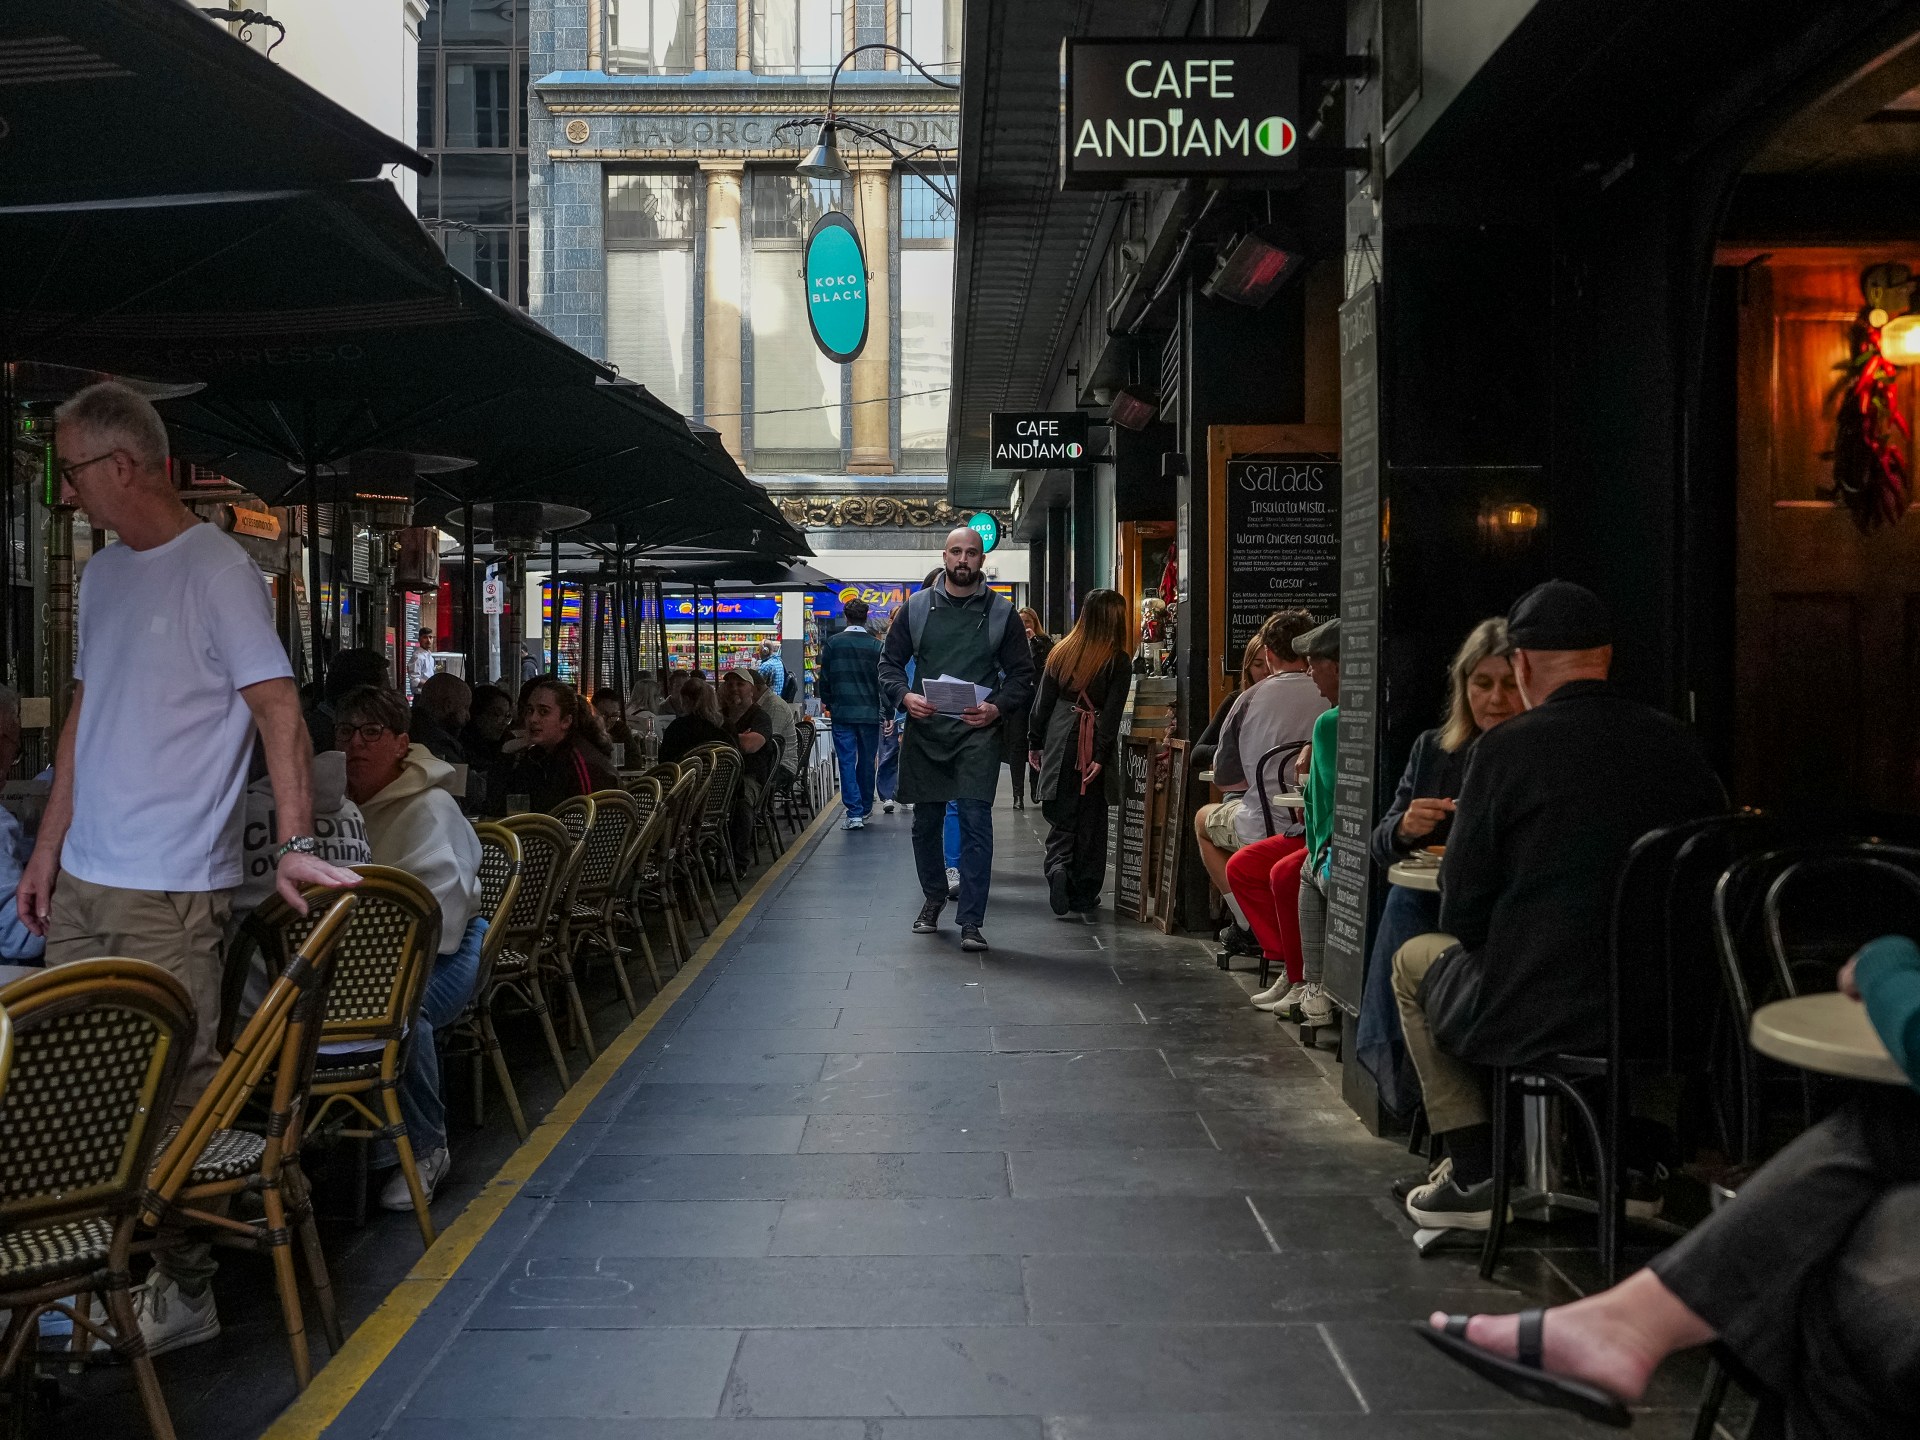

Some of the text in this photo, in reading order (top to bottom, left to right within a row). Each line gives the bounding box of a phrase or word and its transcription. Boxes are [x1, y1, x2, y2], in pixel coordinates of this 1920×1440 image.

[1125, 59, 1235, 99] CAFE
[616, 119, 790, 144] MAJORCA
[1073, 108, 1297, 157] ANDIAMO
[815, 275, 857, 287] KOKO
[812, 290, 862, 303] BLACK
[167, 343, 364, 367] ESPRESSO
[1016, 420, 1059, 436] CAFE
[996, 439, 1083, 459] ANDIAMO
[1251, 501, 1326, 513] Insalata Mista
[1236, 533, 1265, 544] Warm
[1267, 533, 1302, 544] Chicken
[1270, 578, 1304, 589] Caesar
[861, 588, 911, 606] EzyM
